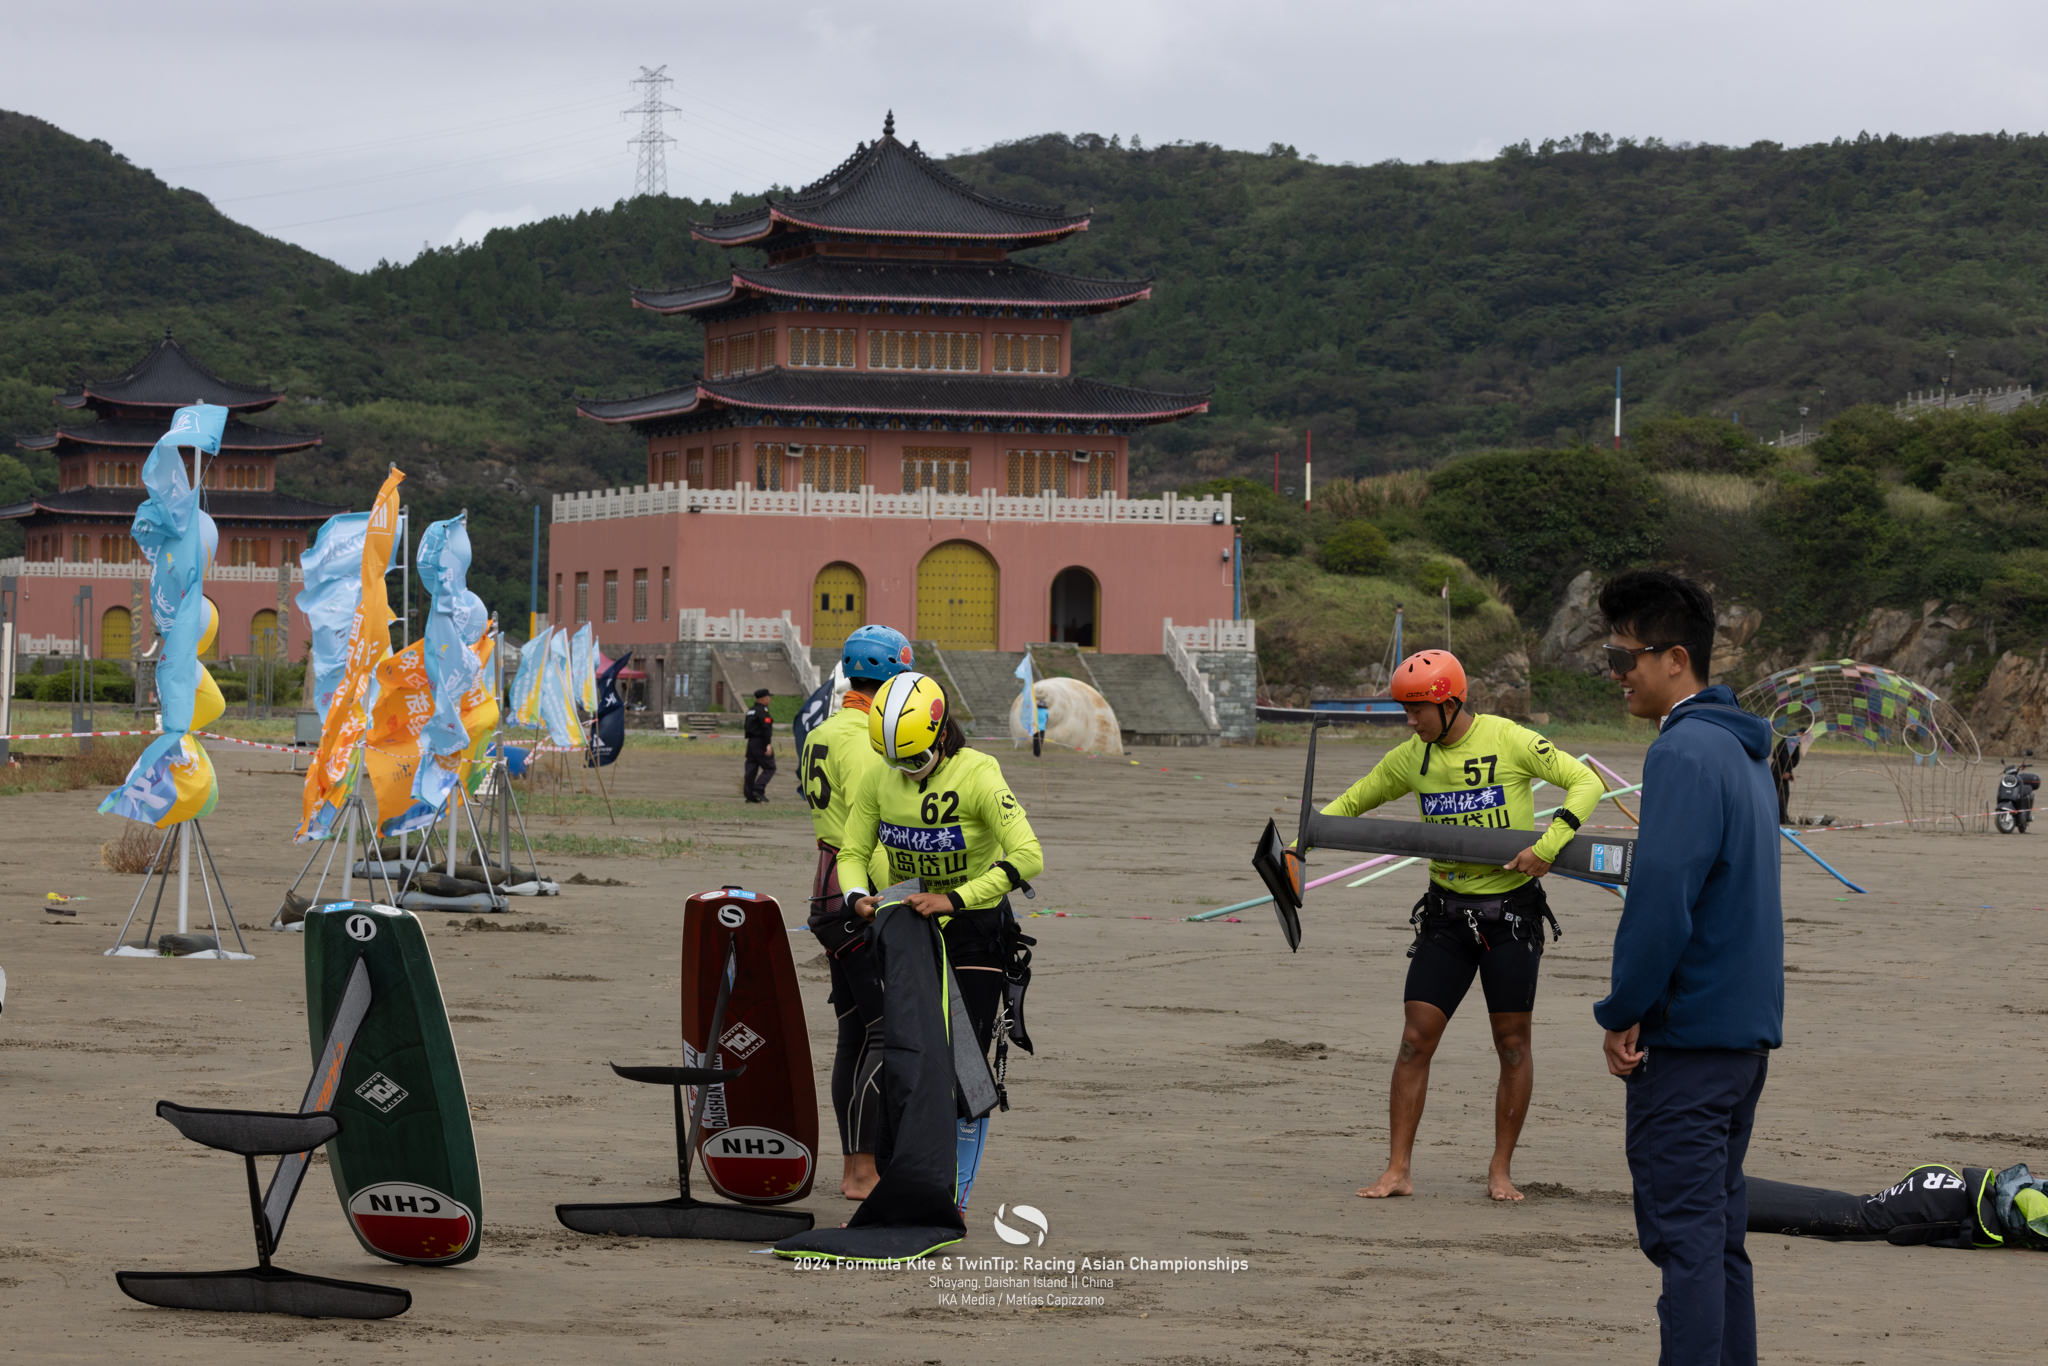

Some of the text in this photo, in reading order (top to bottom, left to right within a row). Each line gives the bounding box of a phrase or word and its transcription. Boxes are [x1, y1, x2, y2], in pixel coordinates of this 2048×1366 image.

[1463, 754, 1498, 787] 57
[920, 790, 960, 825] 62
[1424, 786, 1498, 816] 沙洲优黄
[879, 823, 956, 852] 沙洲优黄
[888, 852, 968, 875] 岛岱山
[708, 1086, 728, 1128] DAISHAN
[722, 1138, 785, 1155] CHN
[1923, 1172, 1966, 1191] ER
[369, 1194, 441, 1214] CHN
